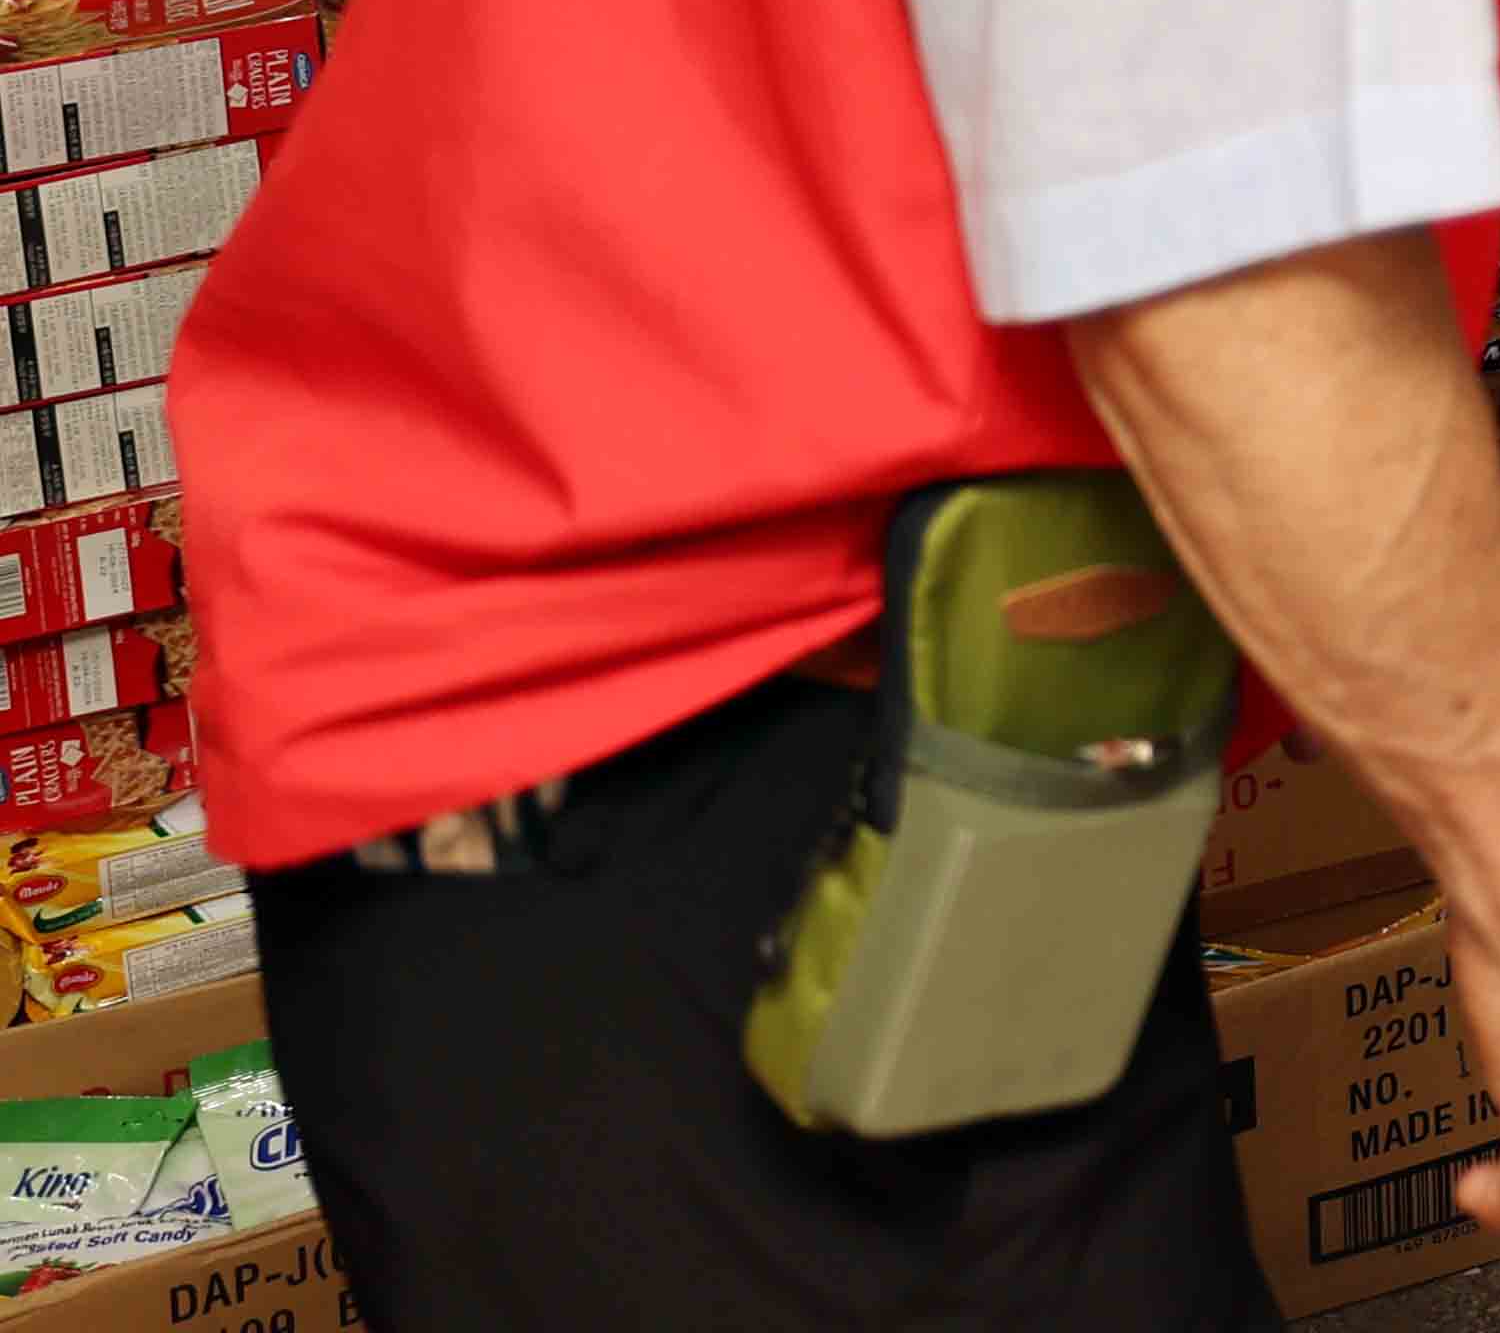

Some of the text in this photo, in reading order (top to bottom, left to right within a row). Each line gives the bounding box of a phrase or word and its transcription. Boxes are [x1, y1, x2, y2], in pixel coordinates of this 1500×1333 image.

[265, 48, 292, 108] PLAIN
[9, 743, 41, 809] PLAIN
[1363, 1005, 1448, 1060] 2201
[1348, 1077, 1413, 1115] NO.
[1351, 1102, 1454, 1162] MADE
[87, 1226, 198, 1250] Soft Candy
